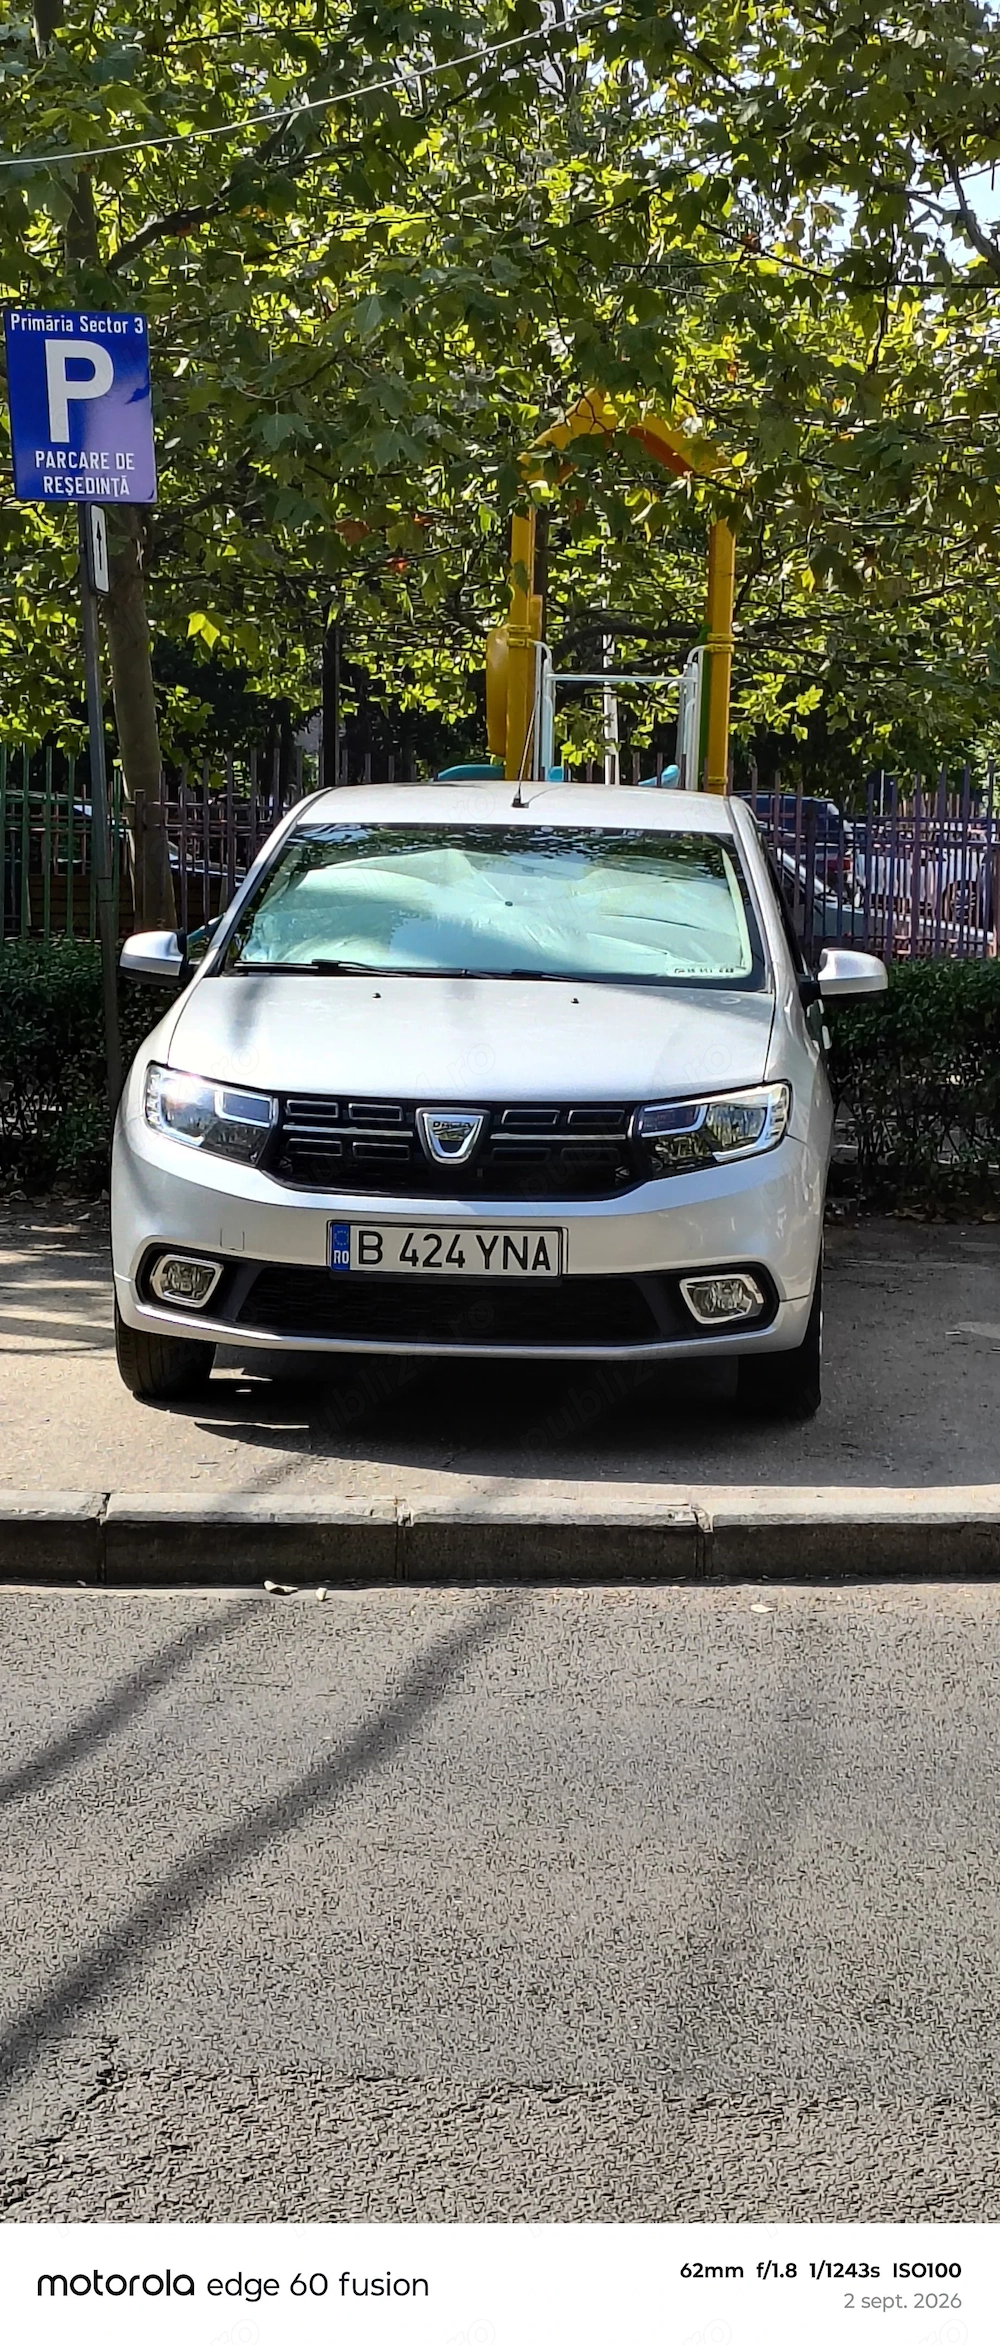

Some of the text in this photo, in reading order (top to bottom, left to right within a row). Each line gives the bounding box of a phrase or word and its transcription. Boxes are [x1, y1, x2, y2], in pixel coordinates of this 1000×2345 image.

[80, 315, 128, 334] Sector
[134, 317, 144, 334] 3
[45, 339, 114, 443] P
[35, 450, 135, 470] PARCARE DE
[333, 1250, 349, 1264] RO
[358, 1230, 551, 1270] B 424 YNA
